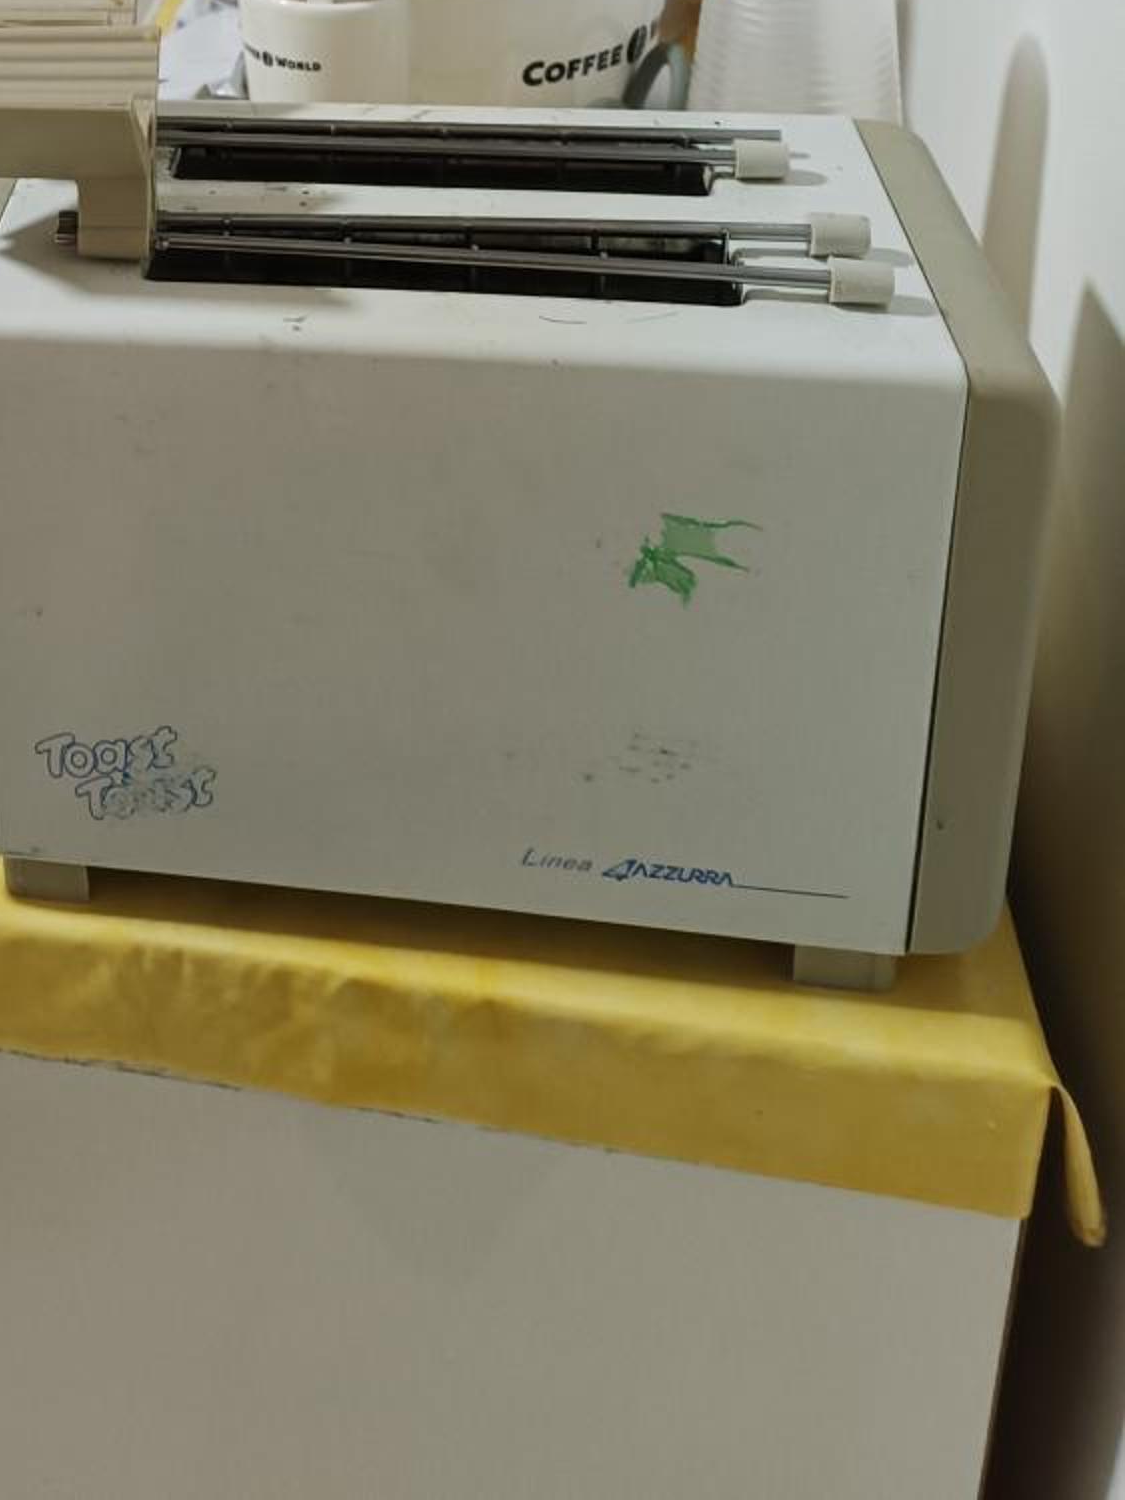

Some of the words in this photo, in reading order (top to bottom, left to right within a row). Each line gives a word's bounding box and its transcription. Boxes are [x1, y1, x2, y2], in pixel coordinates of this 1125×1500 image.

[275, 56, 322, 72] WORLD
[522, 44, 624, 86] COFFEE
[35, 726, 177, 779] Toast
[522, 847, 593, 872] Linea
